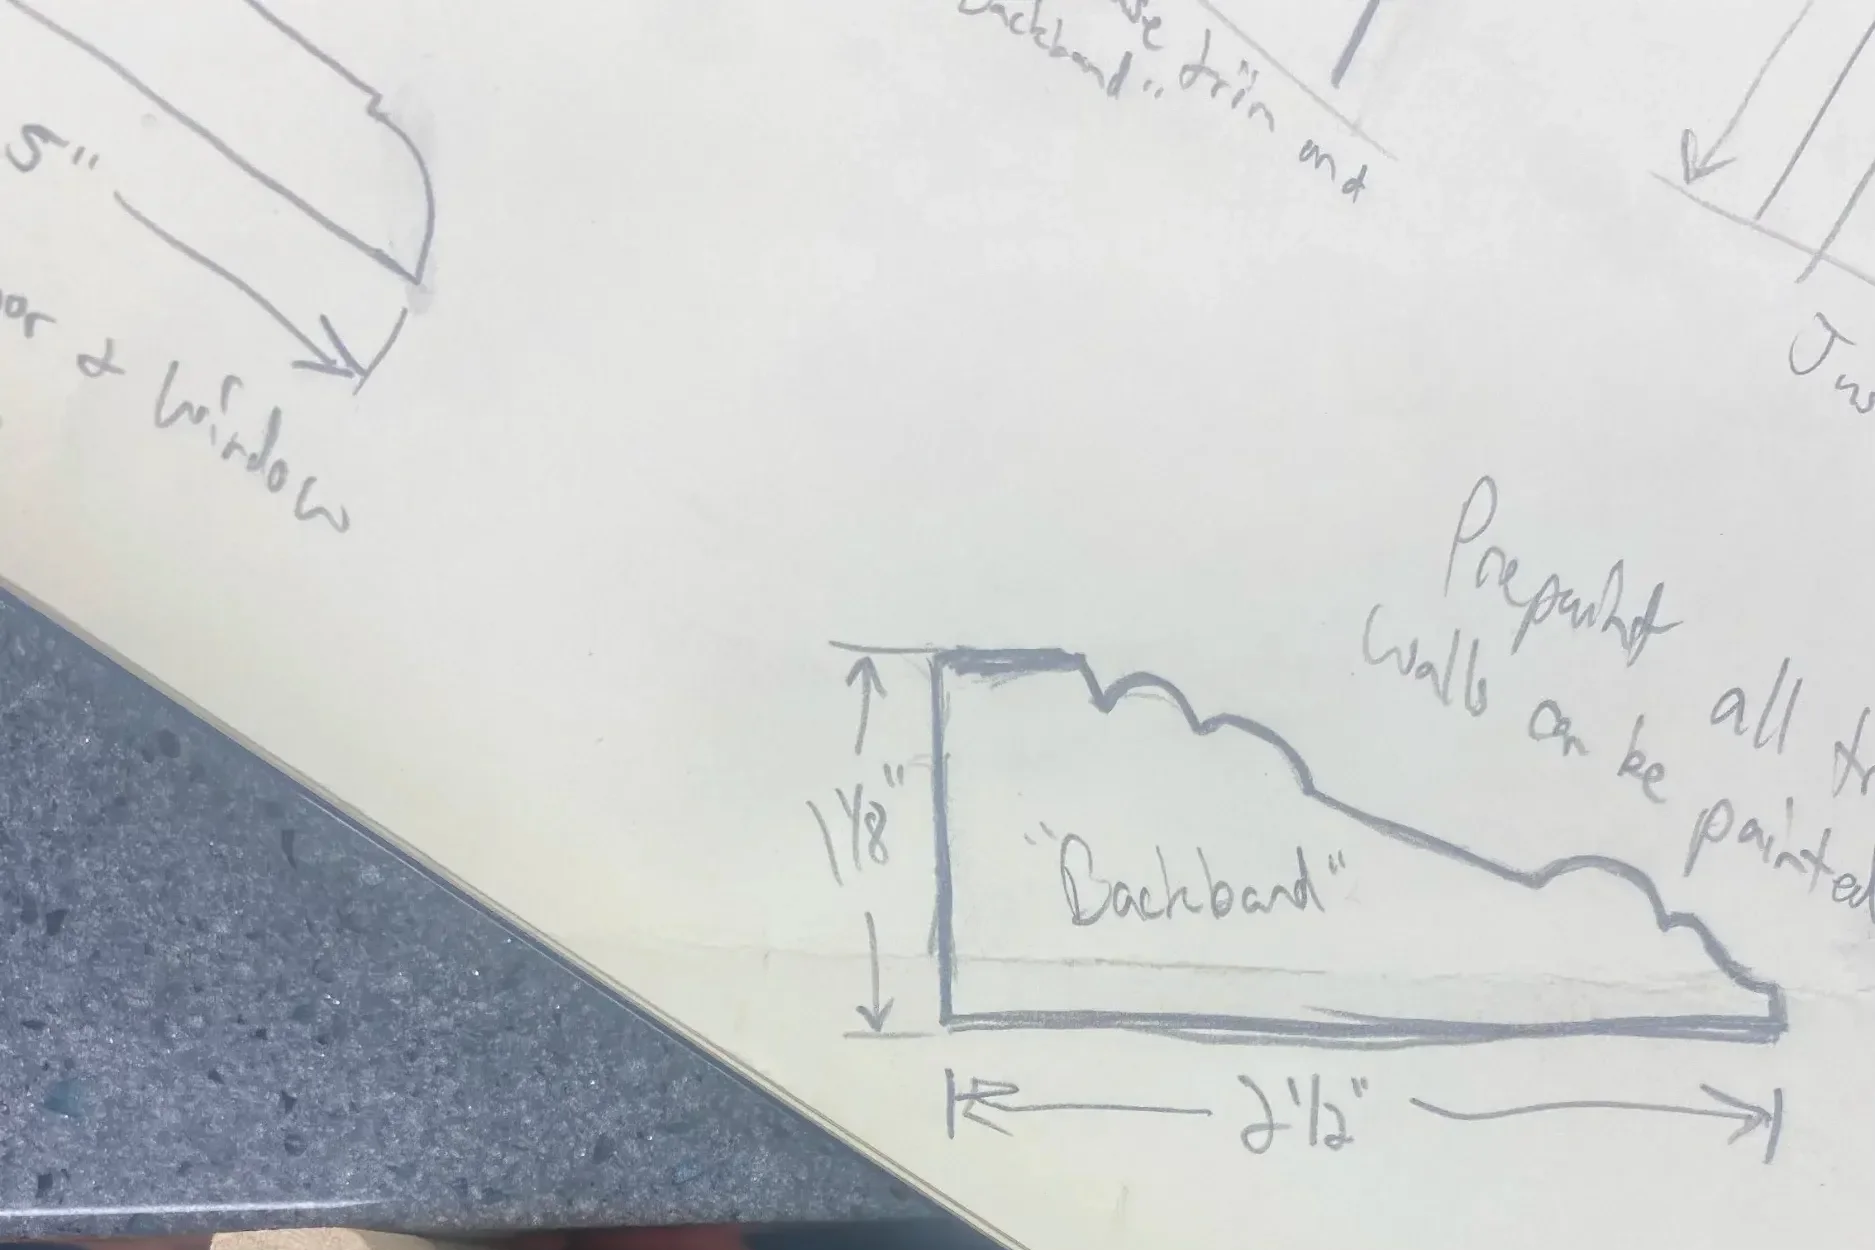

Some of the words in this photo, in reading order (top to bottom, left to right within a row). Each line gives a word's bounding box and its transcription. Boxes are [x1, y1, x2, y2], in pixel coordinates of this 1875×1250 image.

[1299, 138, 1369, 203] and
[0, 287, 58, 340] or
[1710, 656, 1803, 755] all
[1528, 699, 1590, 757] can
[1616, 714, 1667, 804] be
